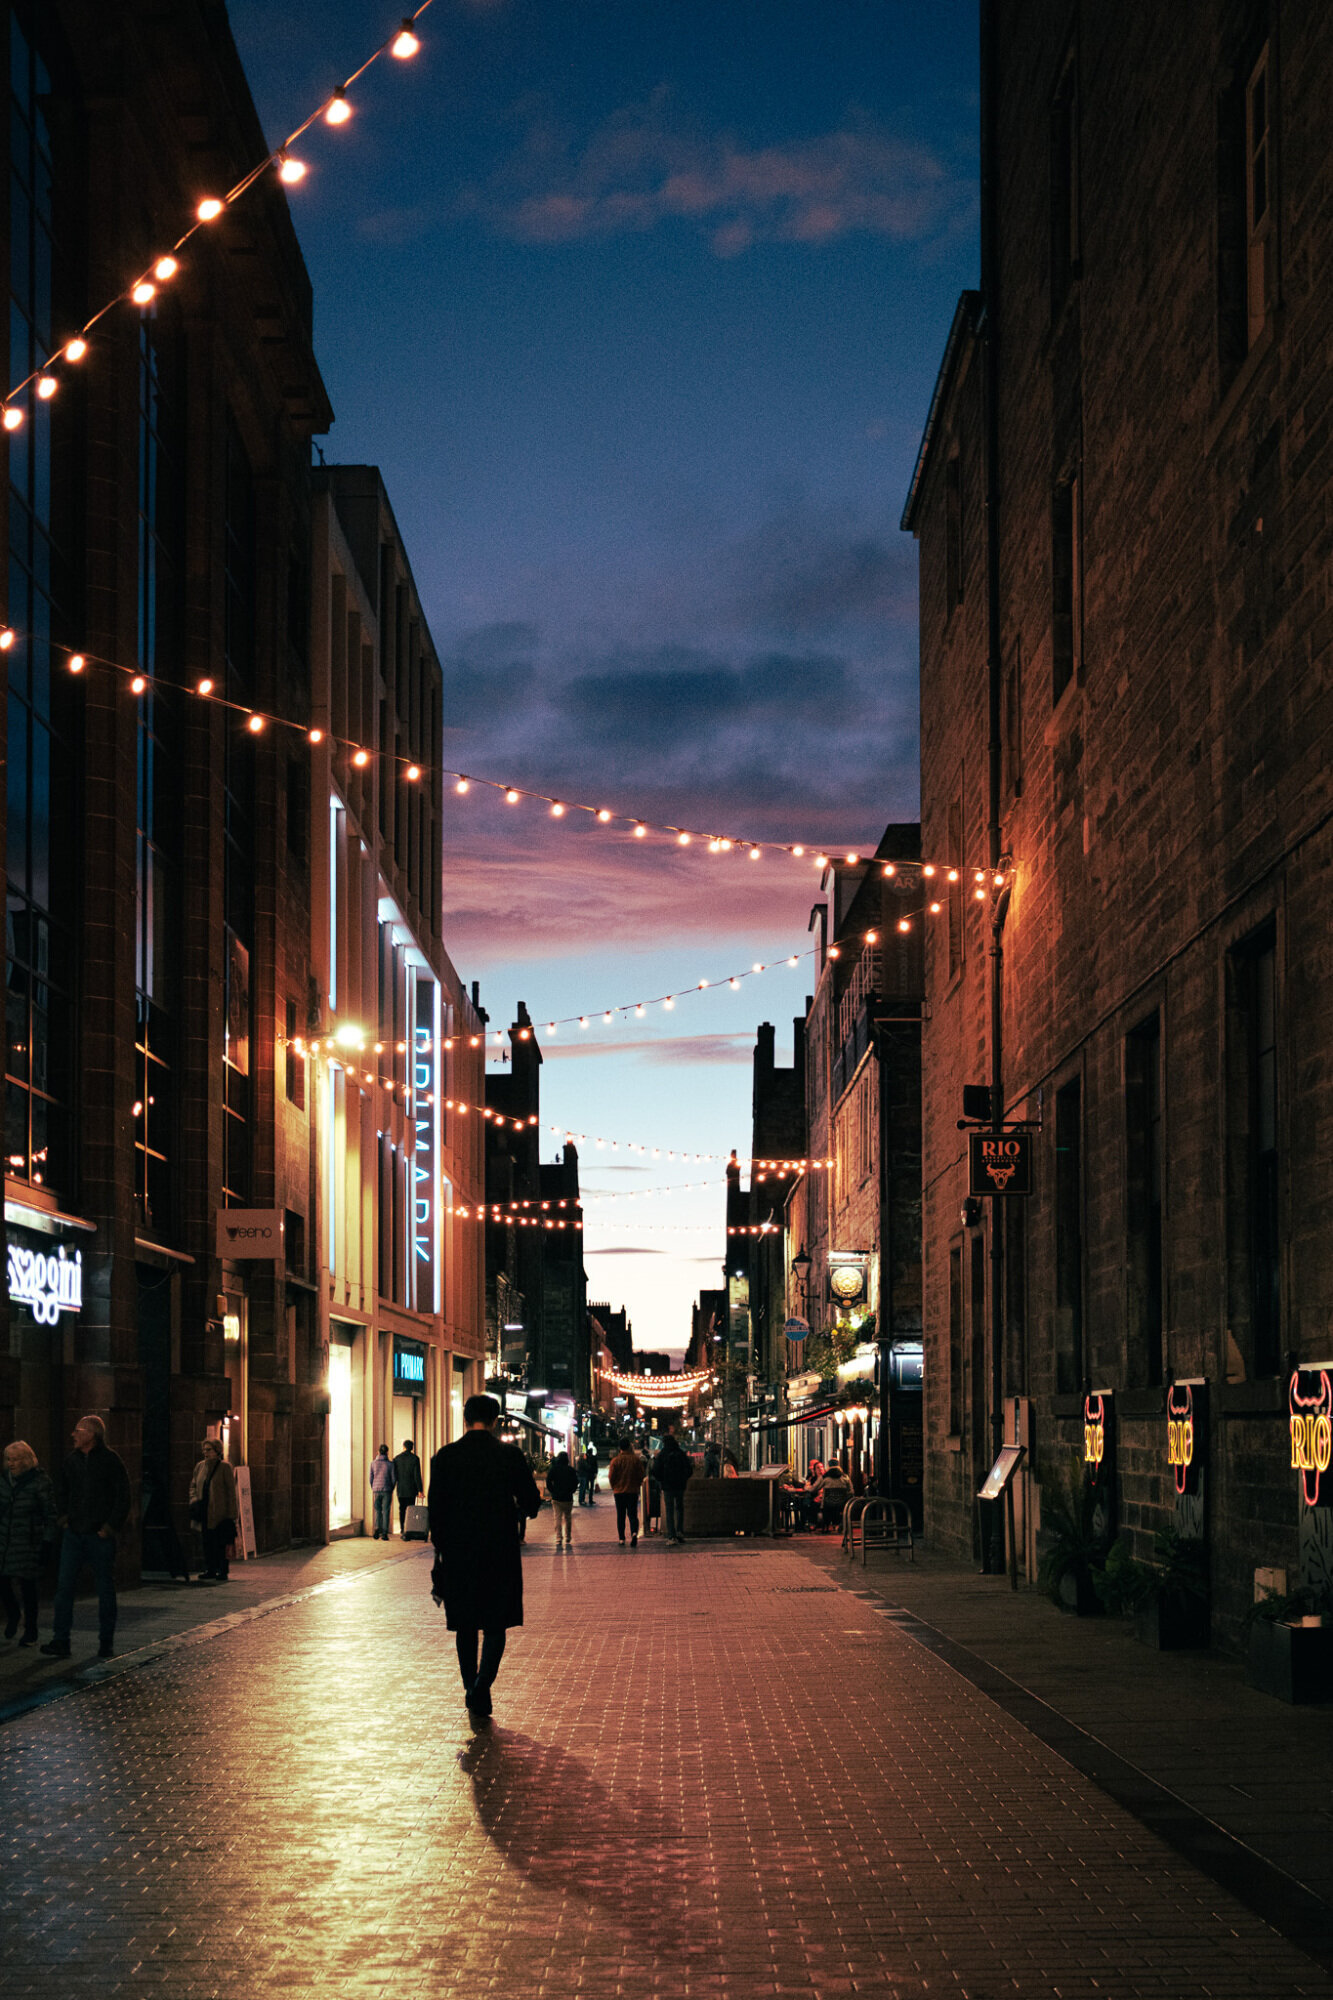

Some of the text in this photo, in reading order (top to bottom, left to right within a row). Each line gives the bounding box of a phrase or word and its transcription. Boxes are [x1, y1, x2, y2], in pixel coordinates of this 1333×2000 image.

[982, 1140, 1021, 1157] RIO
[1085, 1424, 1104, 1463] RIO
[1168, 1420, 1193, 1466] RIO
[1290, 1414, 1331, 1472] RIO
